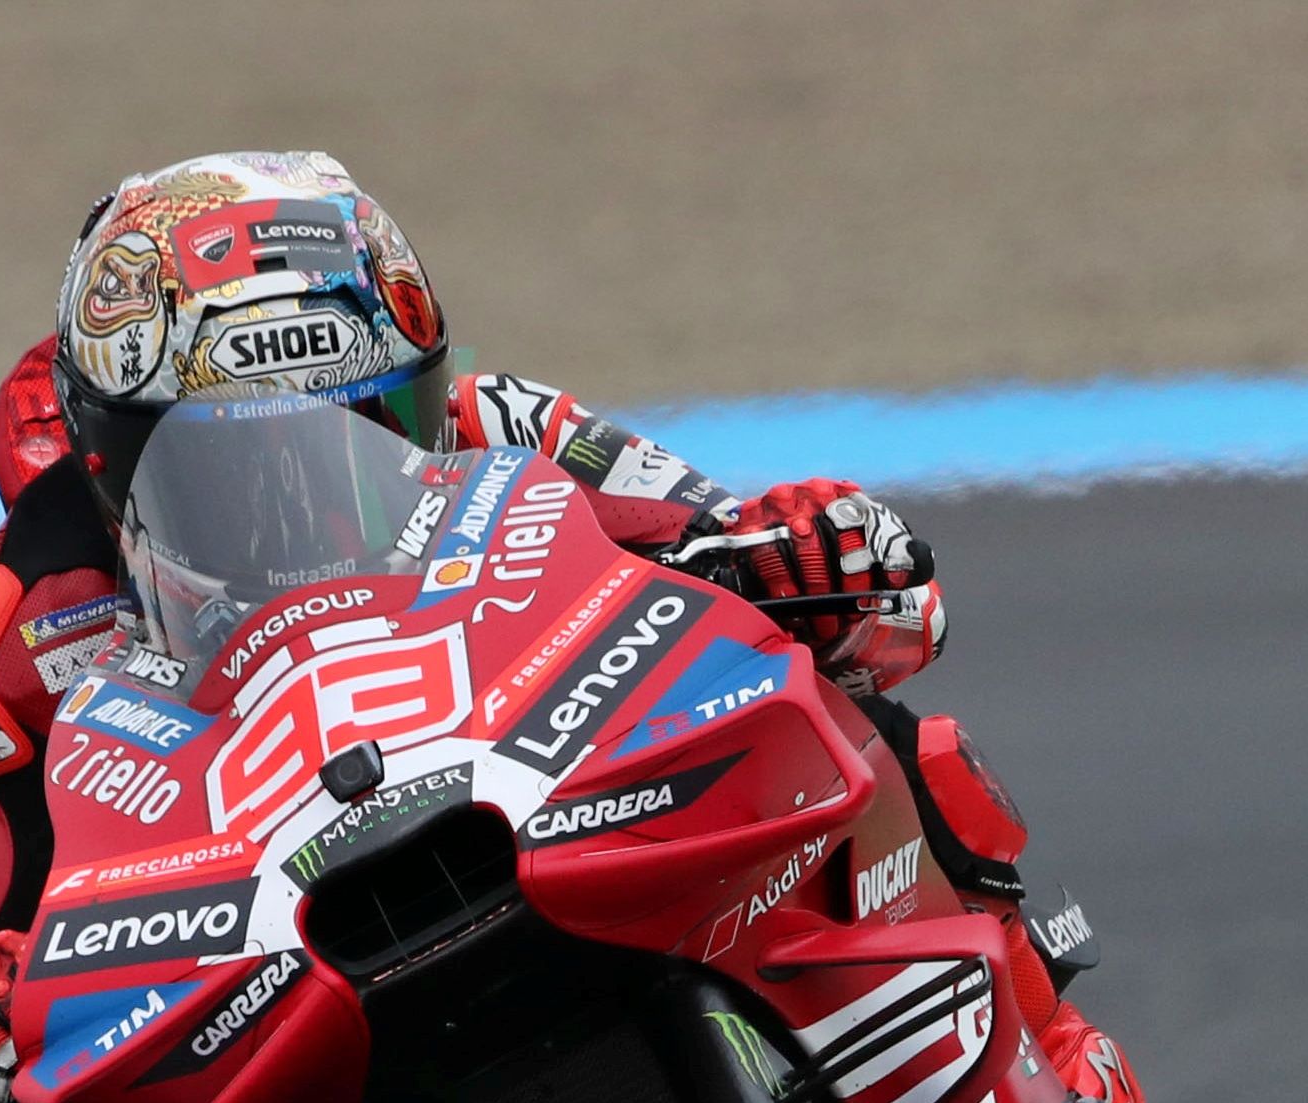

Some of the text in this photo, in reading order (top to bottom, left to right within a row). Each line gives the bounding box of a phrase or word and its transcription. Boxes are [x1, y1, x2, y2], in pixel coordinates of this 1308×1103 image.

[254, 224, 337, 241] Lenovo
[229, 320, 341, 370] SHOEI
[232, 401, 293, 420] Estrella
[396, 490, 447, 559] WRS
[460, 451, 523, 544] ADVANCE
[489, 481, 577, 582] riello
[267, 559, 356, 587] Insta360
[220, 588, 375, 681] VARGROUP
[511, 566, 635, 688] FRECCIAROSSA
[126, 649, 188, 689] WRS
[513, 595, 686, 760] Lenovo
[694, 677, 775, 720] TIM
[90, 697, 192, 750] ADVANCE
[209, 620, 473, 842] 93
[73, 747, 182, 825] riello
[526, 784, 675, 841] CARRERA
[346, 792, 447, 845] ENERGY
[96, 841, 245, 883] FRECCIAROSSA
[746, 853, 801, 927] Audi
[856, 836, 923, 921] DUCATI
[44, 902, 238, 963] Lenovo
[94, 988, 167, 1052] TIM
[191, 950, 301, 1058] CARRERA
